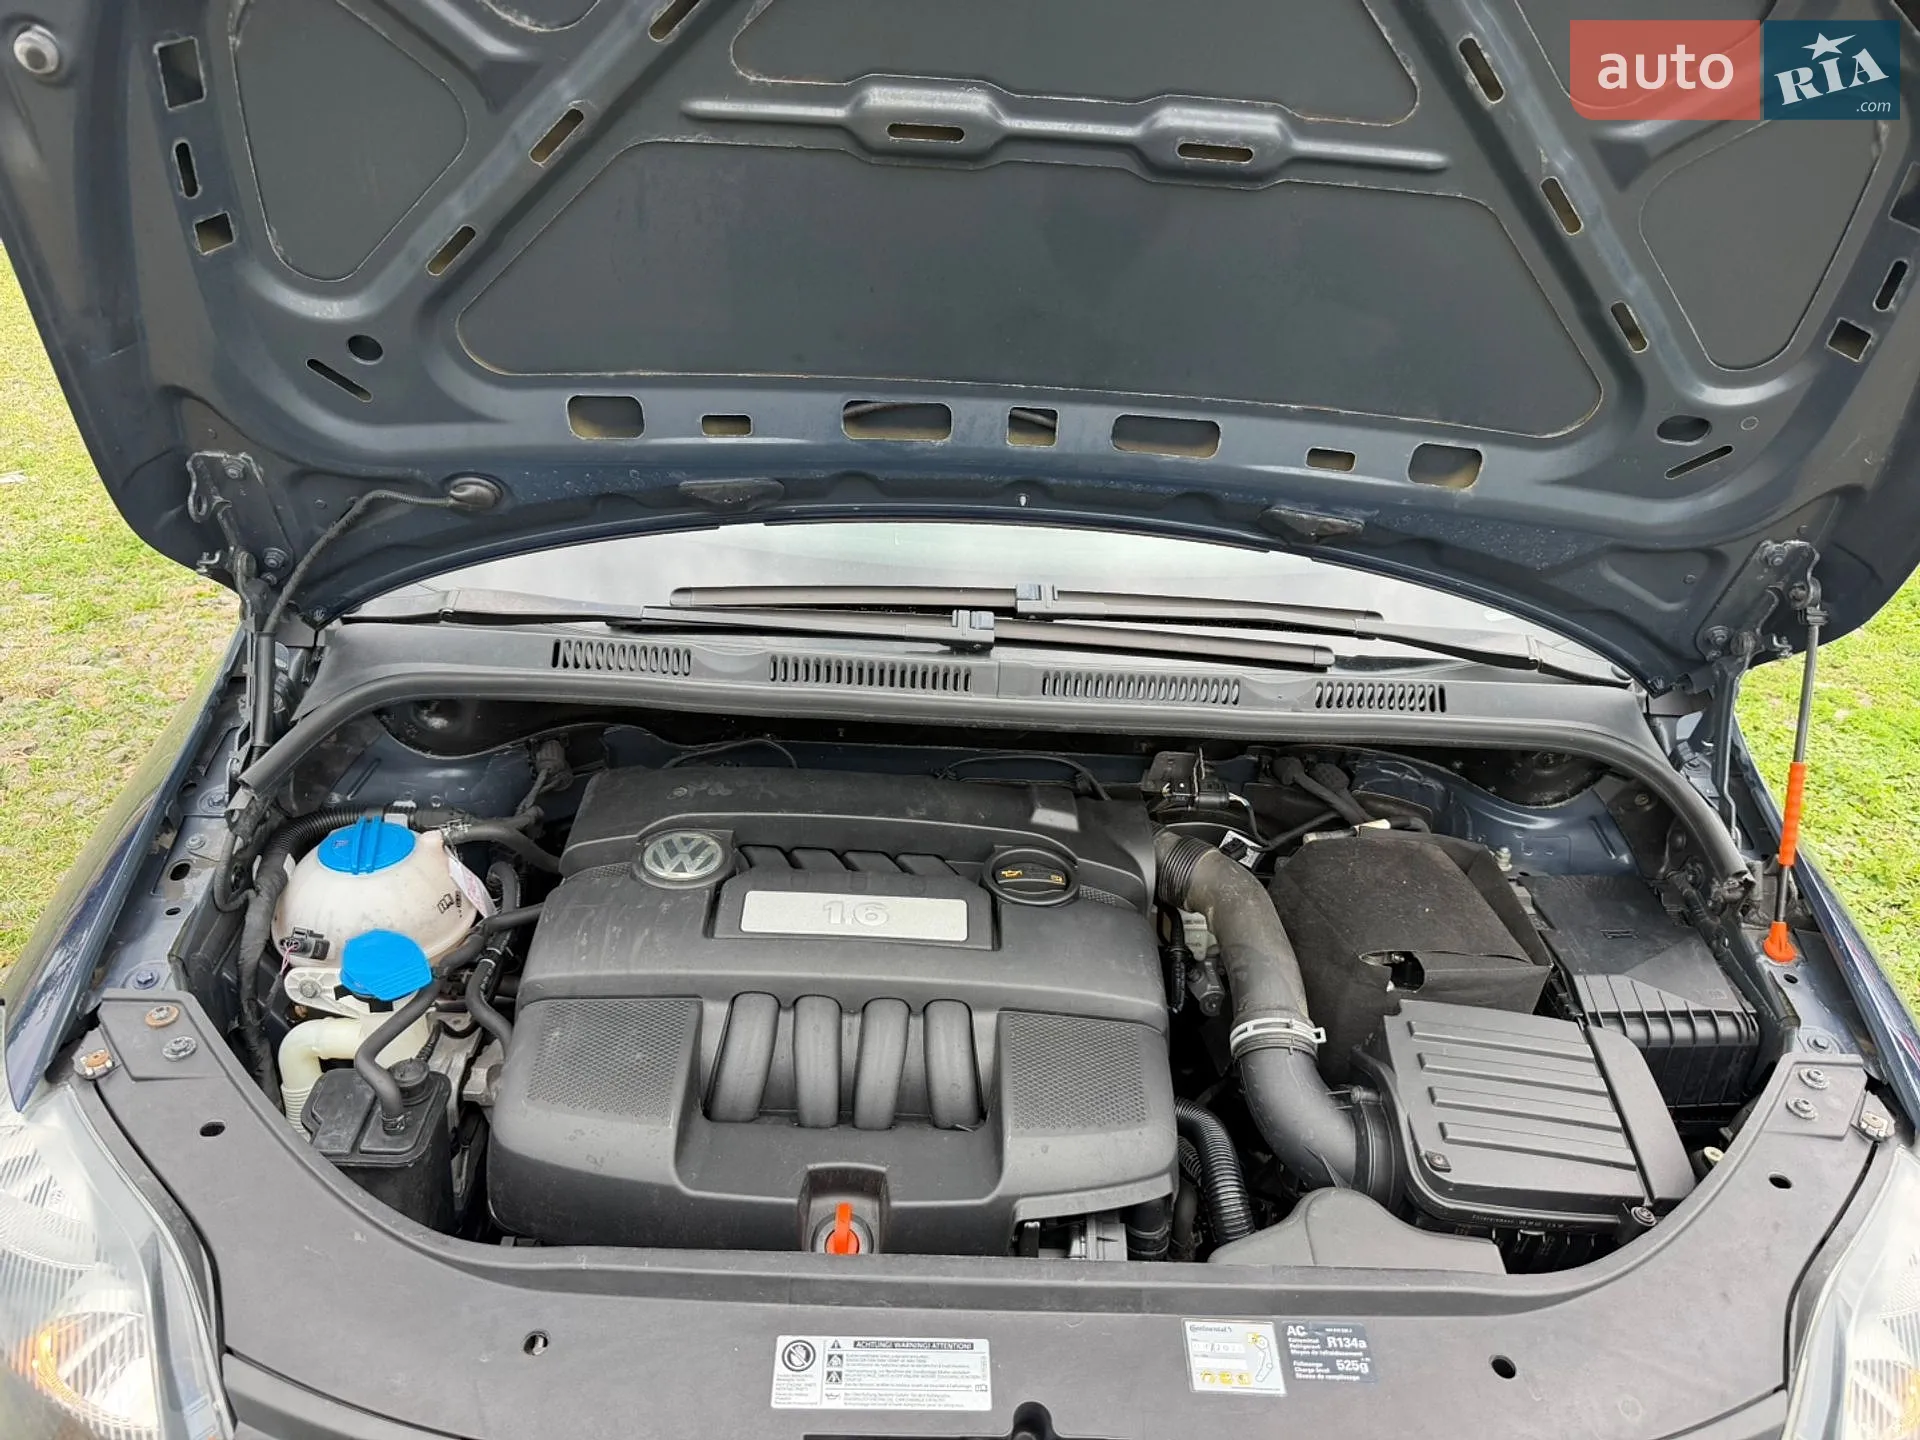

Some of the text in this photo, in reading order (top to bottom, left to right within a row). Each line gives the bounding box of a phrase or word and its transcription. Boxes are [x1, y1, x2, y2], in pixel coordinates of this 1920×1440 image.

[1286, 1325, 1308, 1337] AC
[1326, 1336, 1367, 1349] R134a
[1335, 1359, 1369, 1374] 525g
